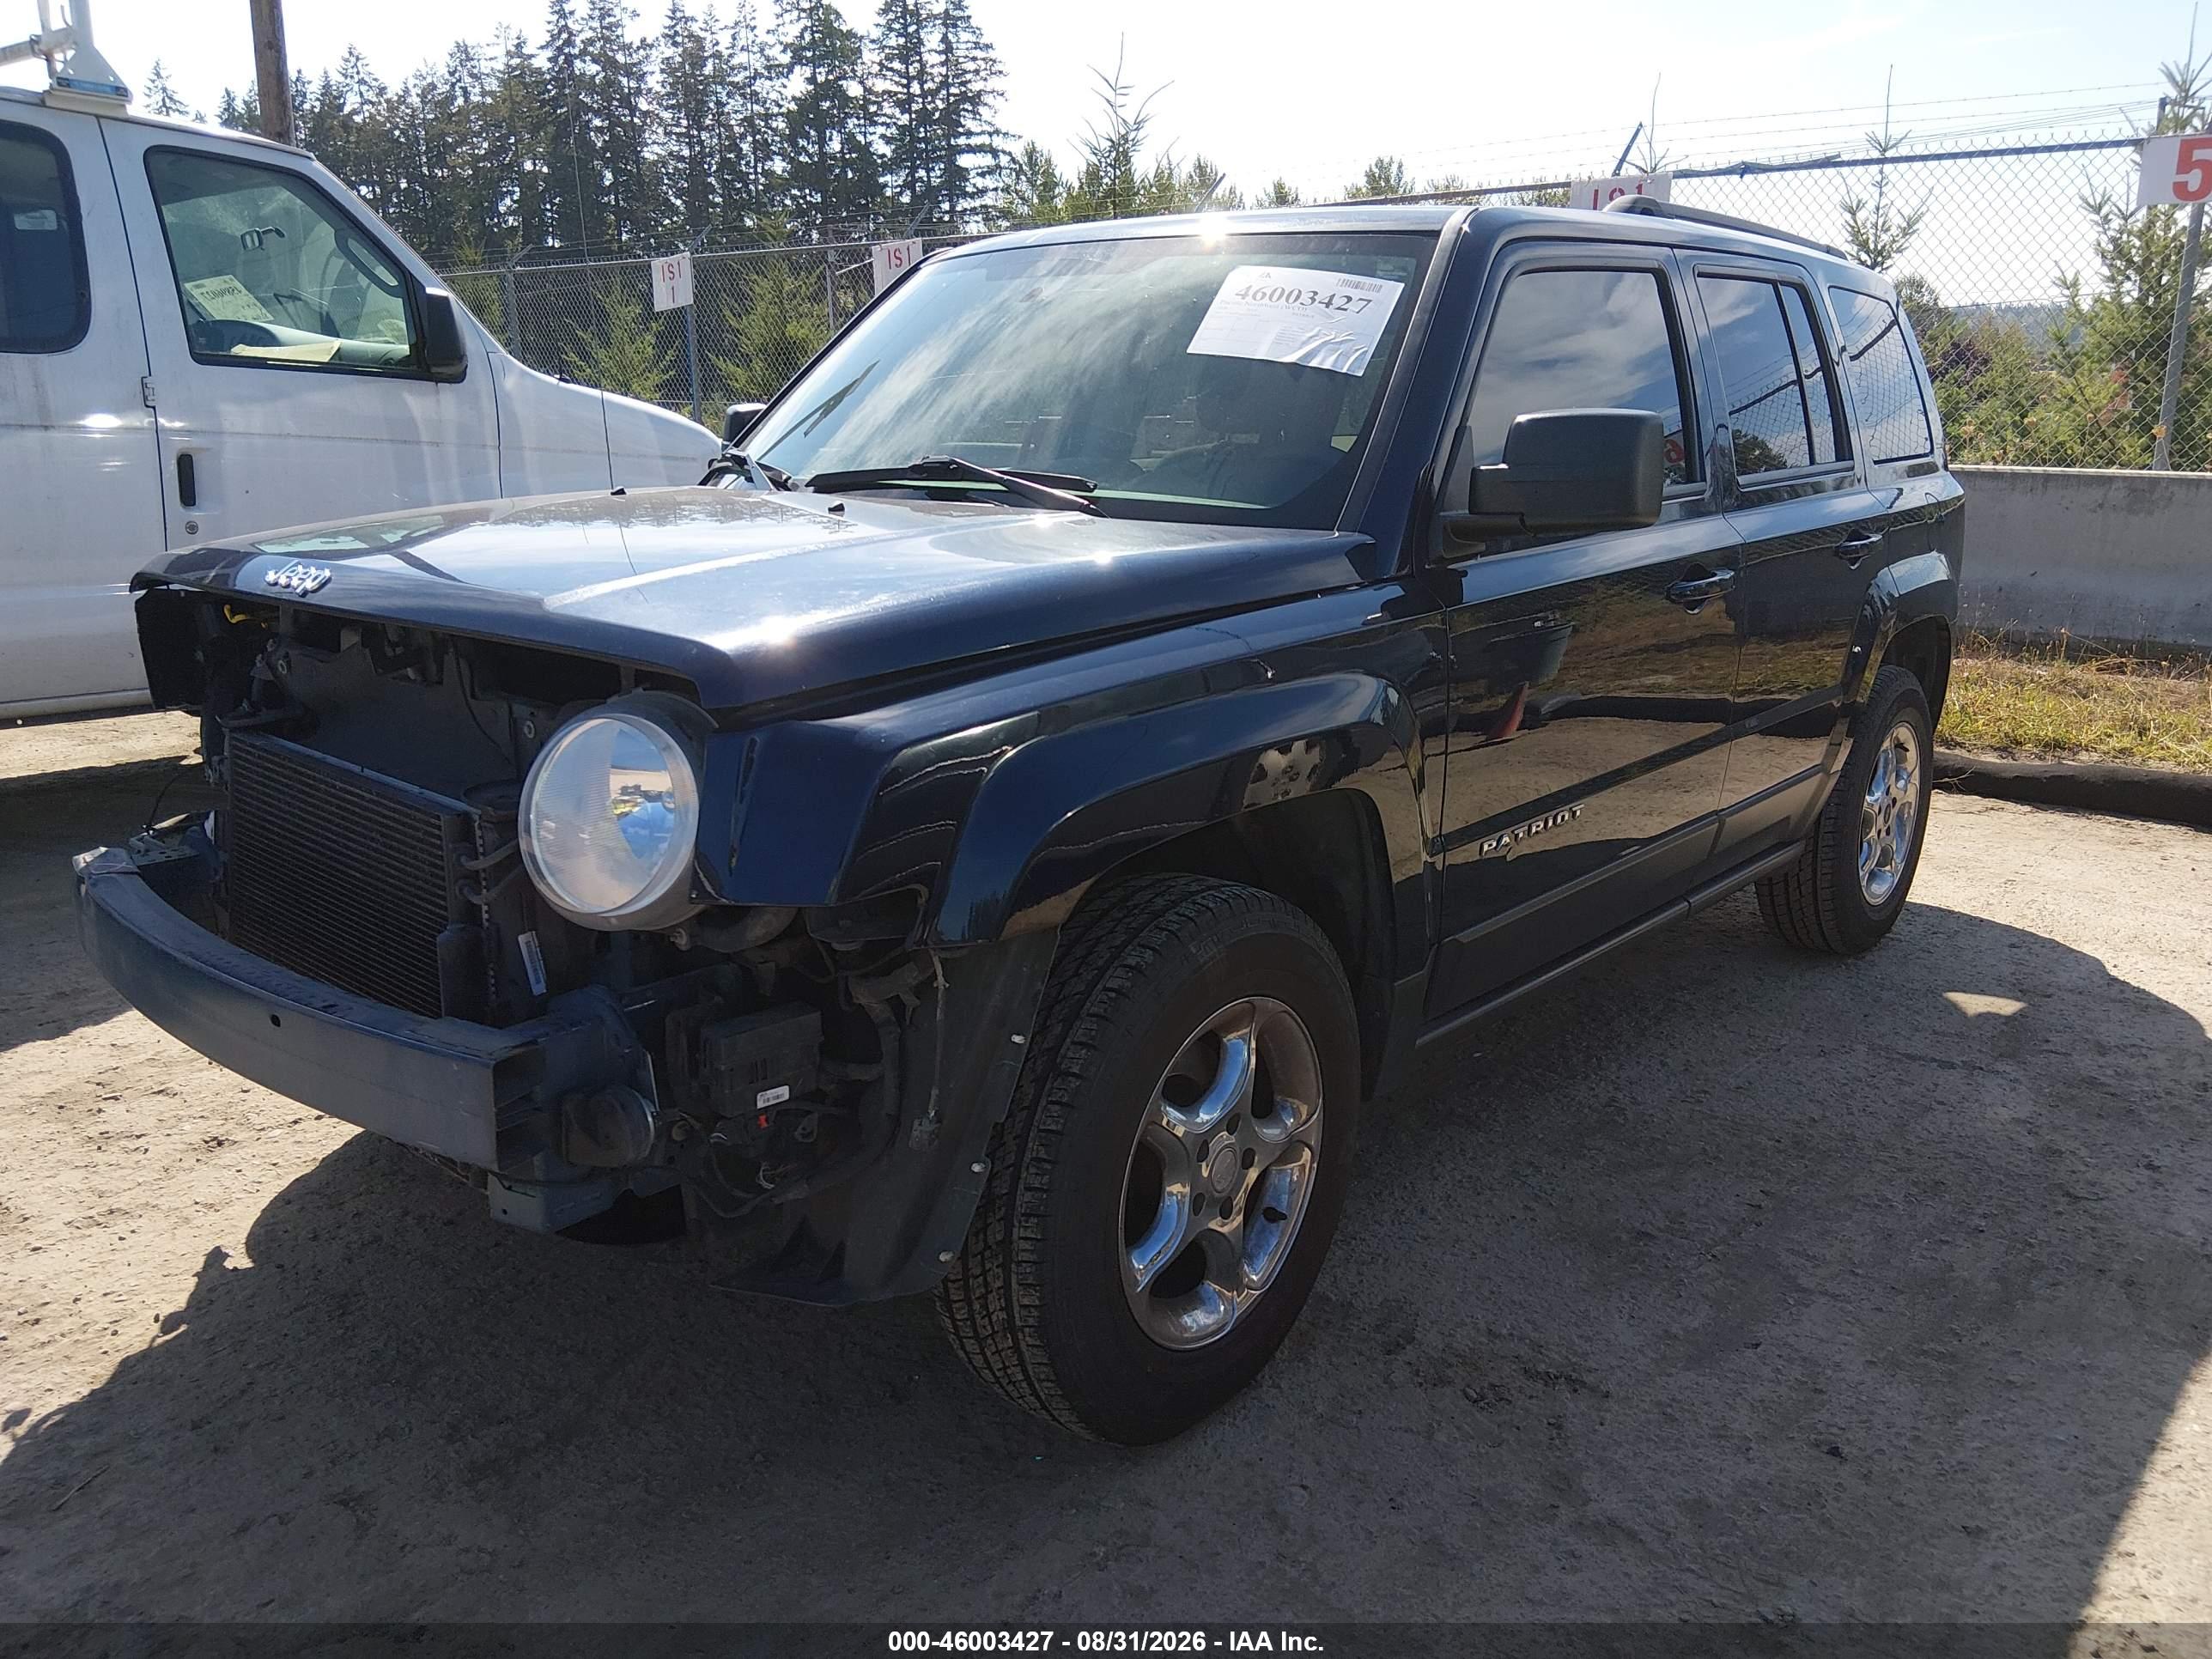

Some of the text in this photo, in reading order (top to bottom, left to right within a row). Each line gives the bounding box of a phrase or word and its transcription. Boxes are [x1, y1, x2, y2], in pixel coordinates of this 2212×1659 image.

[1234, 283, 1374, 315] 46003427
[264, 560, 332, 598] Jeep
[1480, 804, 1585, 857] PATRIOT
